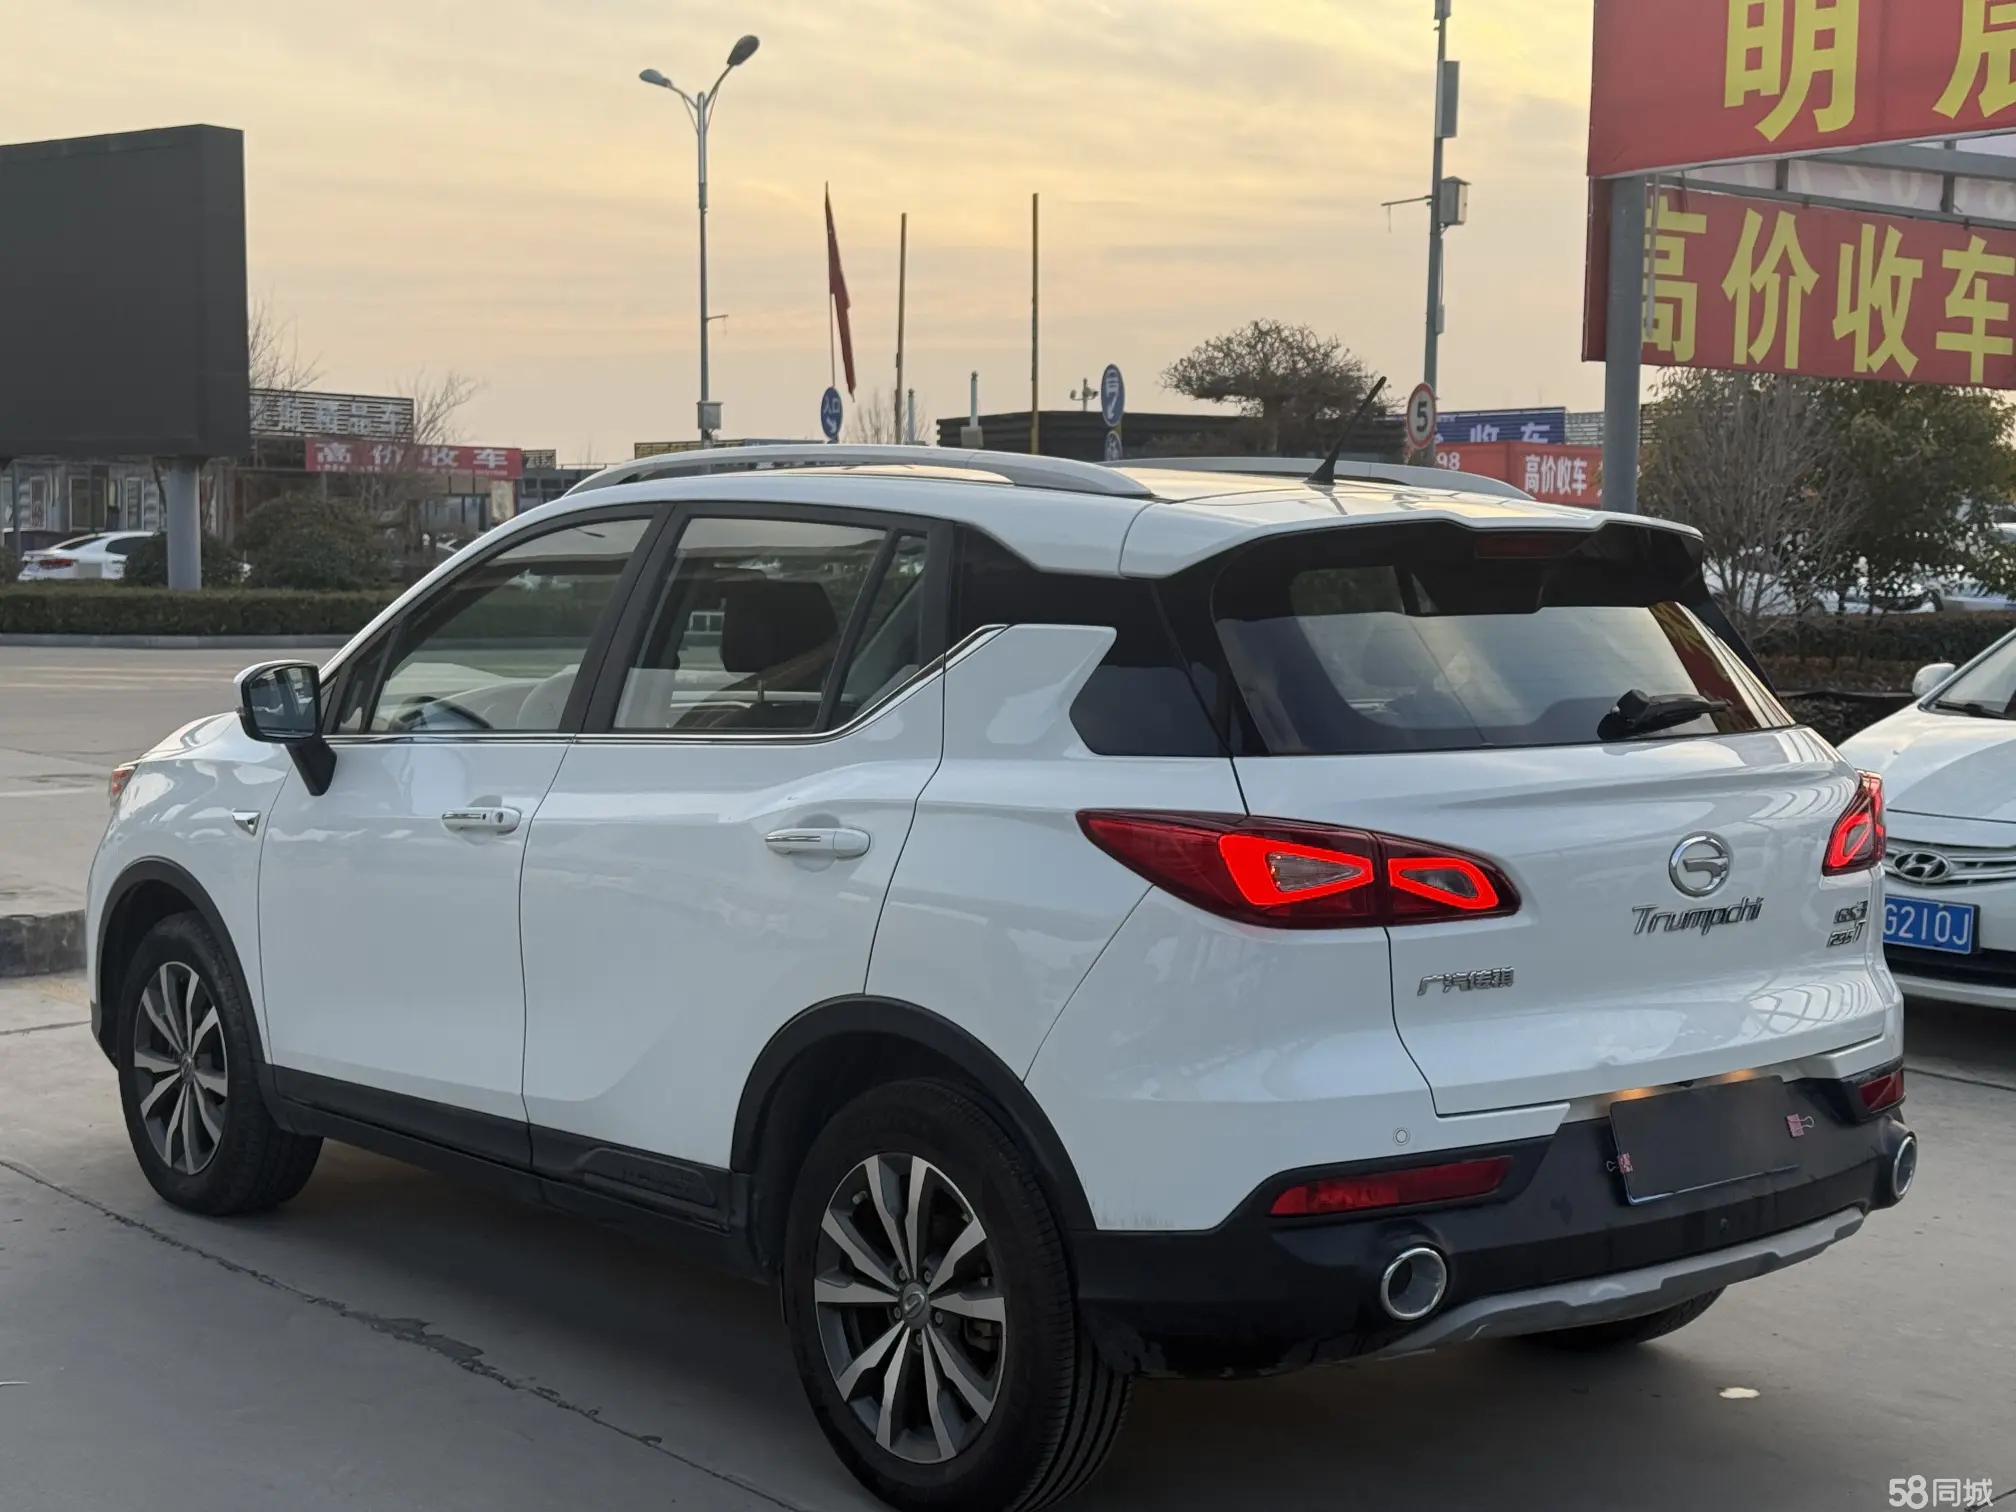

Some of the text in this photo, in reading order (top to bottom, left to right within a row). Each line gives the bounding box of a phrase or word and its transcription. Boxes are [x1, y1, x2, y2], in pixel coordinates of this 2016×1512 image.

[1642, 195, 2016, 384] 高价收车
[1416, 401, 1428, 432] 5
[1524, 454, 1588, 496] 高价收车
[1632, 896, 1764, 936] Trumpchi
[1417, 965, 1515, 997] 广汽传祺
